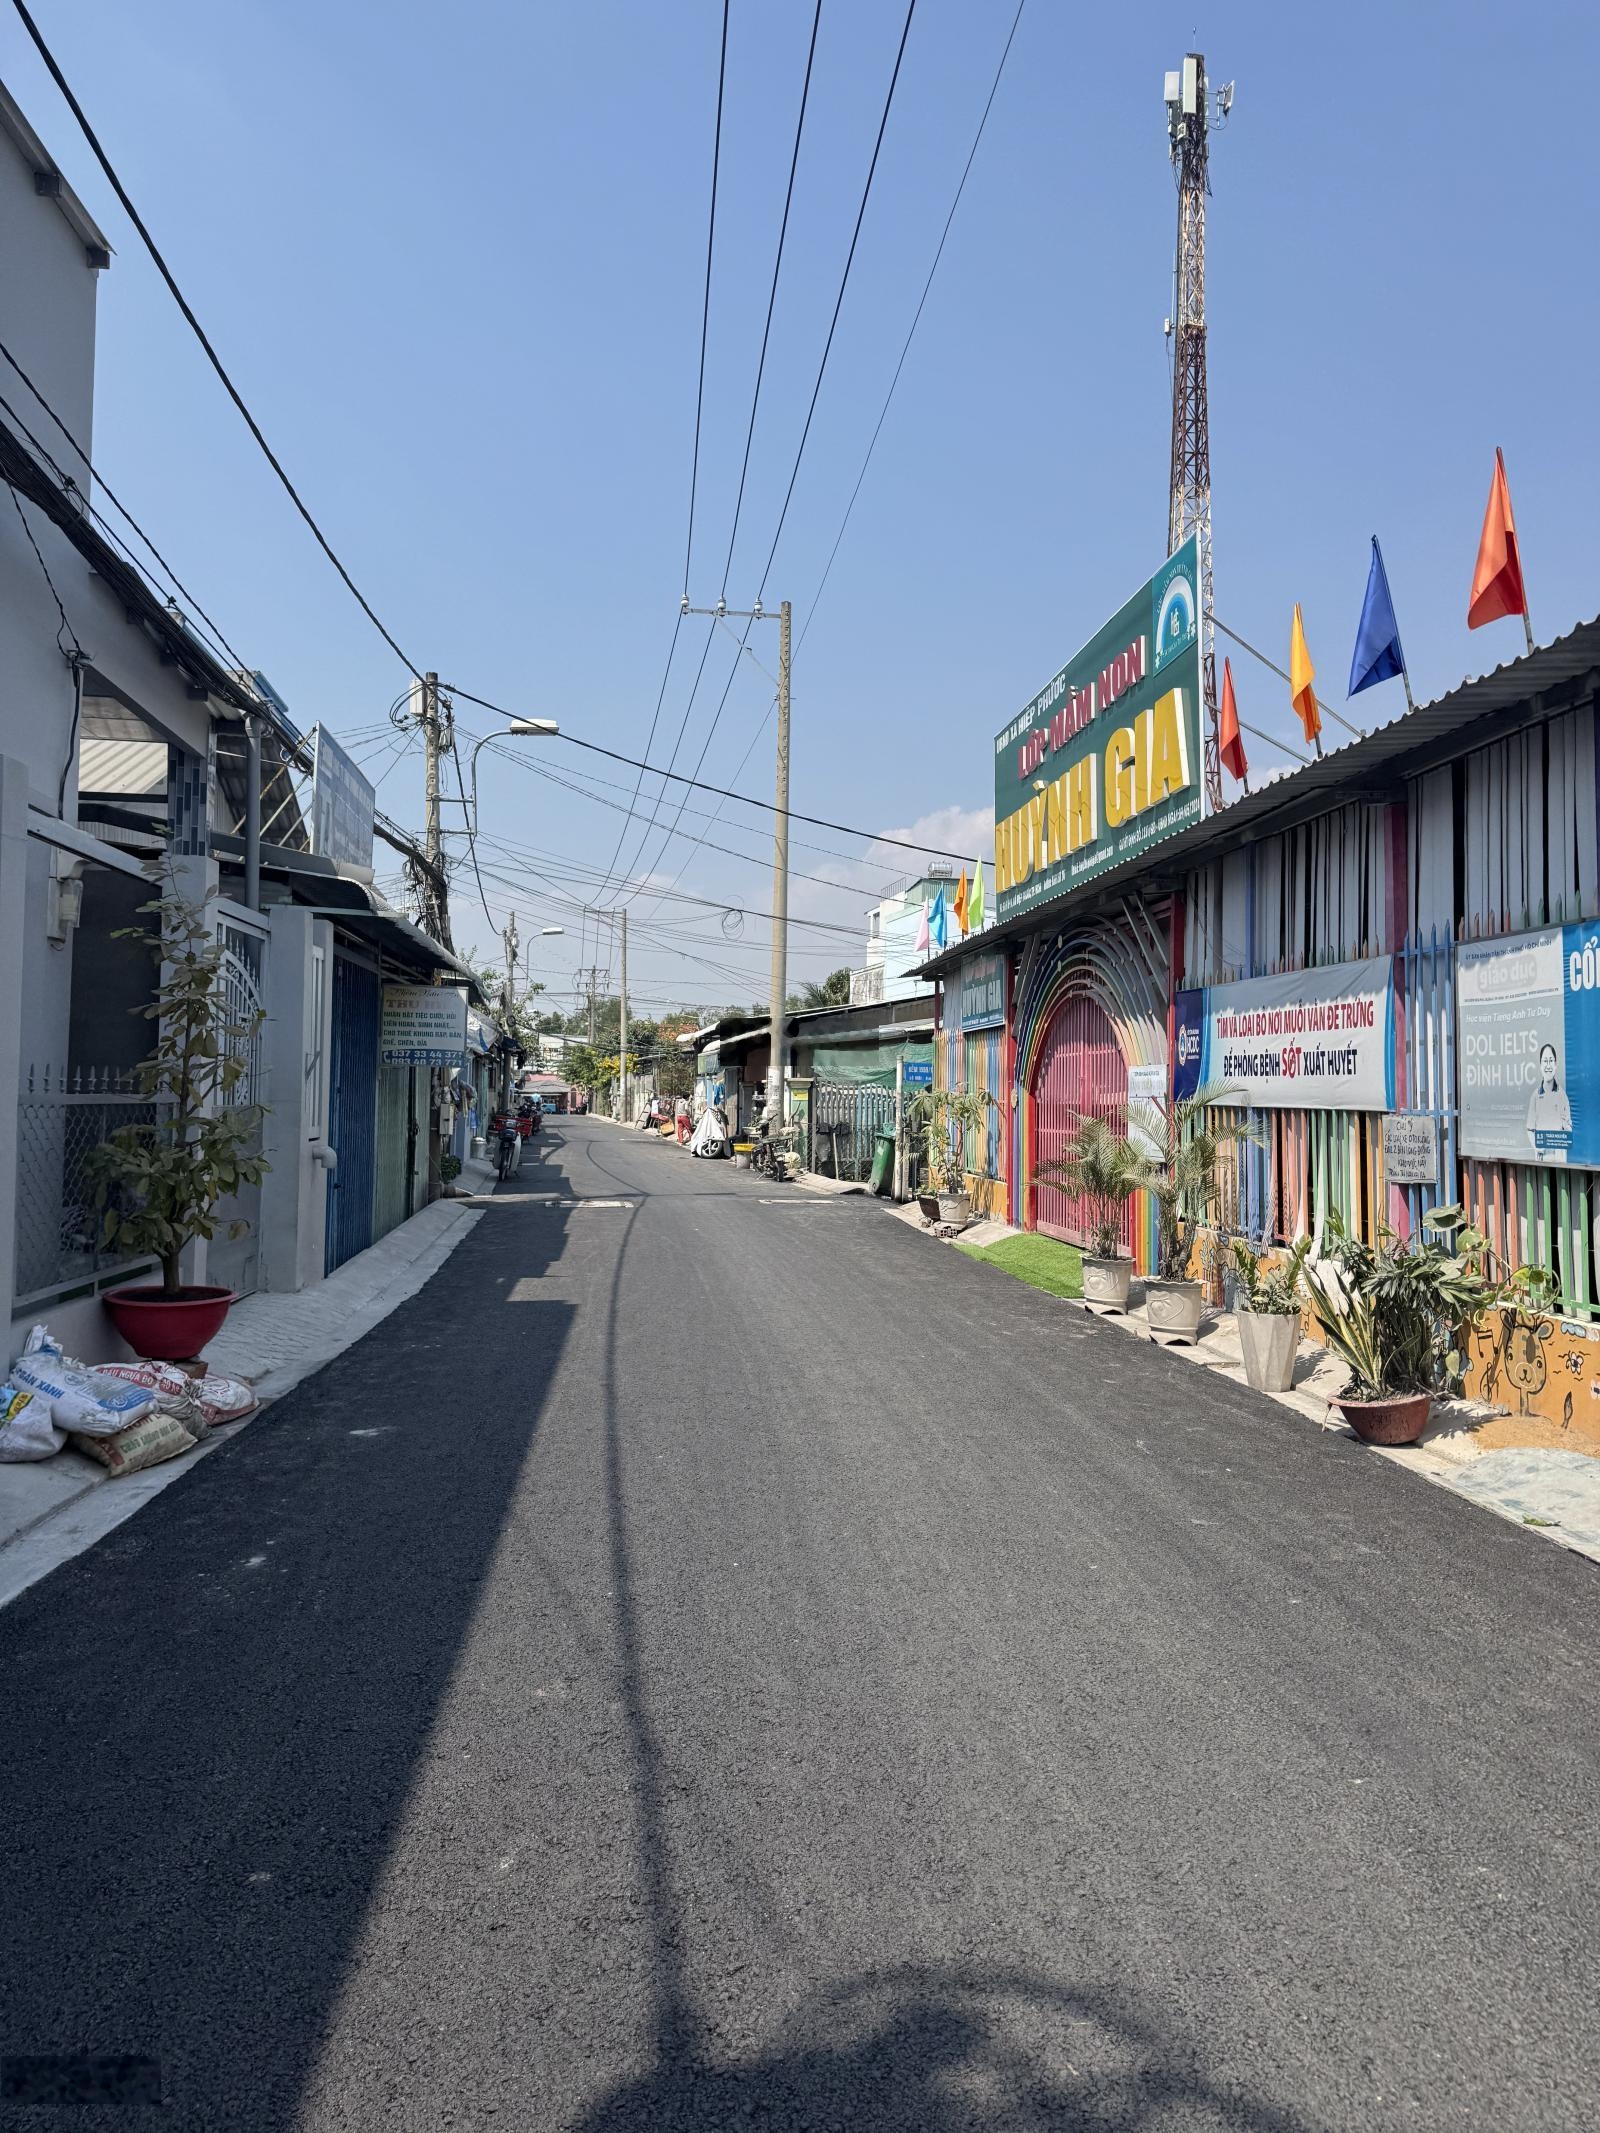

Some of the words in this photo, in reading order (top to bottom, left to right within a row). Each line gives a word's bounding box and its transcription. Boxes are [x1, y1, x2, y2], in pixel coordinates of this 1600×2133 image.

[1018, 728, 1048, 780] LỚP
[1050, 685, 1096, 754] MẦM
[1097, 635, 1146, 712] NON
[995, 753, 1098, 893] HUỲNH
[1105, 687, 1191, 829] GIA
[1570, 936, 1600, 991] CỔ
[962, 983, 987, 1018] HUỲNH
[987, 979, 1002, 1012] GIA
[1537, 1006, 1552, 1017] Duy
[1217, 1013, 1228, 1039] TÌM
[1229, 1011, 1238, 1038] VÀ
[1239, 1014, 1255, 1044] LOẠI
[1256, 1005, 1267, 1037] BỎ
[1283, 998, 1306, 1034] MUỖI
[1341, 995, 1374, 1030] TRỨNG
[414, 1050, 427, 1058] 33
[1233, 1049, 1259, 1077] PHÒNG
[1259, 1048, 1281, 1084] BỆNH
[1281, 1036, 1302, 1078] SỐT
[1303, 1042, 1326, 1076] XUẤT
[1327, 1040, 1358, 1075] HUYẾT
[1466, 1034, 1497, 1056] DOL
[1500, 1029, 1539, 1056] IELTS
[1466, 1058, 1501, 1087] ĐÌNH
[1506, 1061, 1537, 1092] LỰC
[35, 1380, 65, 1399] XANH
